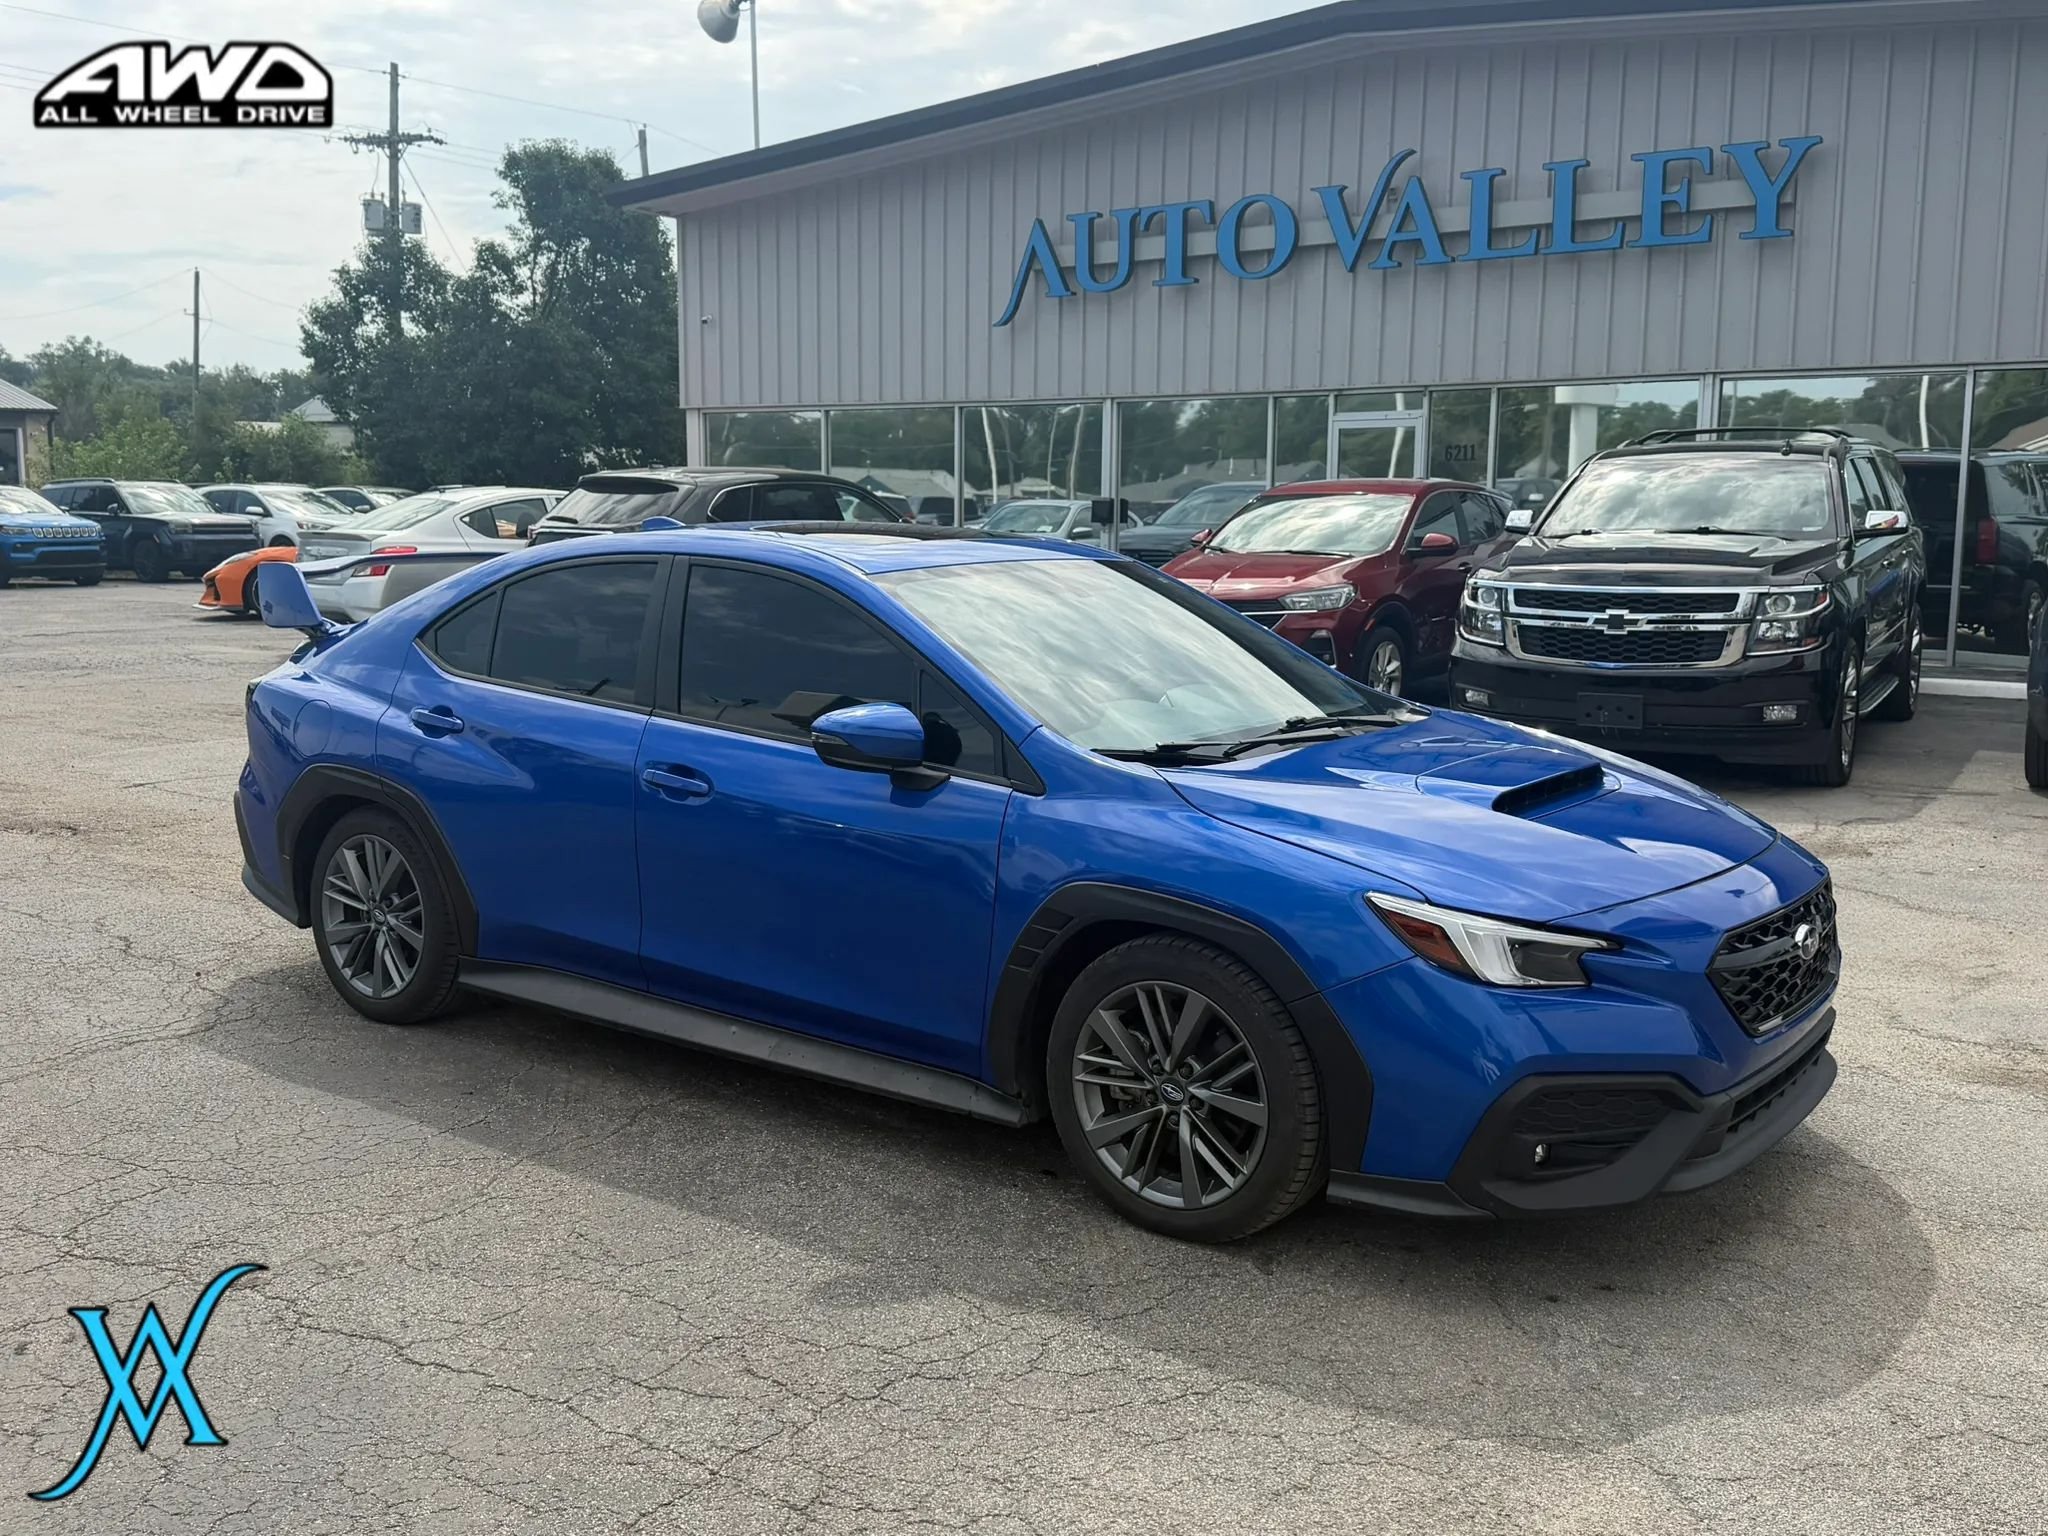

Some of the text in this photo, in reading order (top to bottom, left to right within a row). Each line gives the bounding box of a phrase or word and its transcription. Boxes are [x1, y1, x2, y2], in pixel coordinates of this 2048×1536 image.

[992, 135, 1823, 327] AUTO VALLEY
[1444, 444, 1476, 461] 6211
